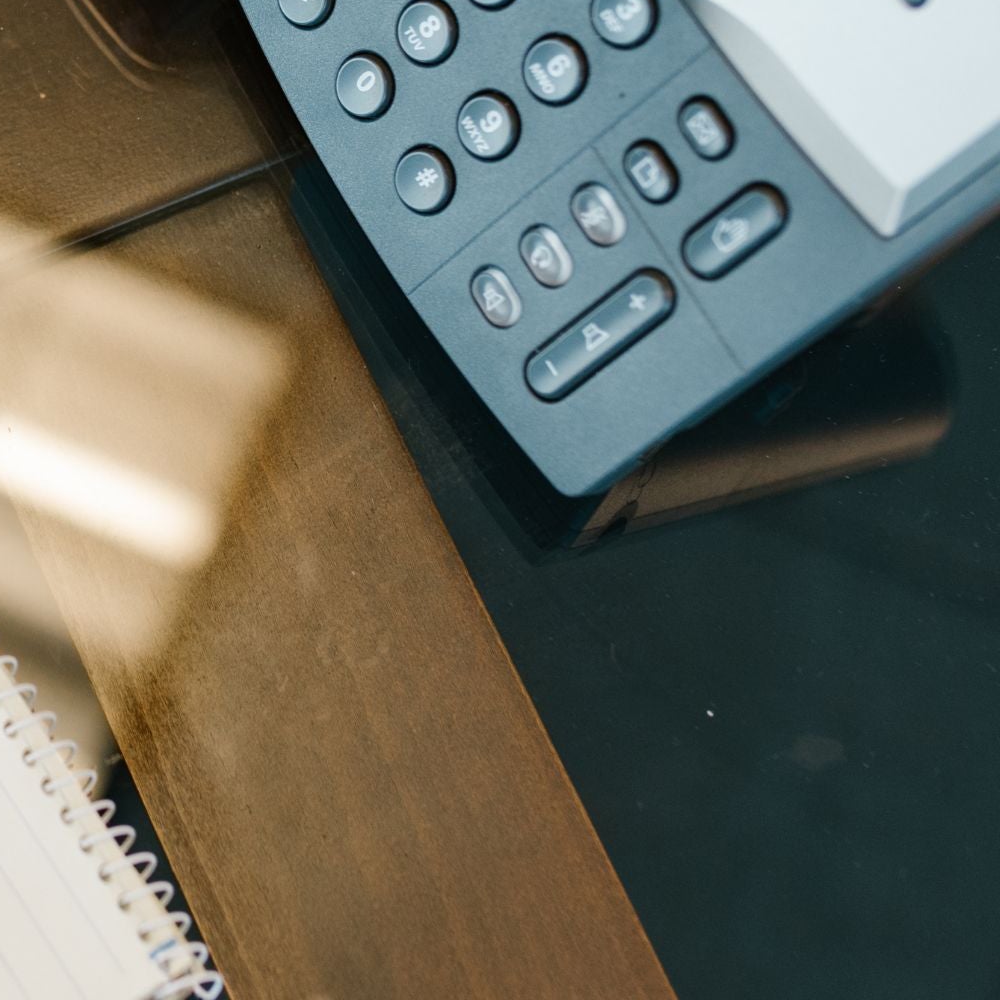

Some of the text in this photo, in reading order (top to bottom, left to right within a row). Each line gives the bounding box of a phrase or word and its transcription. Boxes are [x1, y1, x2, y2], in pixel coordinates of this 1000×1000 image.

[419, 15, 440, 38] 8
[403, 26, 425, 51] TUV
[547, 54, 571, 77] 6
[356, 70, 376, 92] 0
[480, 110, 502, 133] 9
[460, 115, 490, 152] WXYZ
